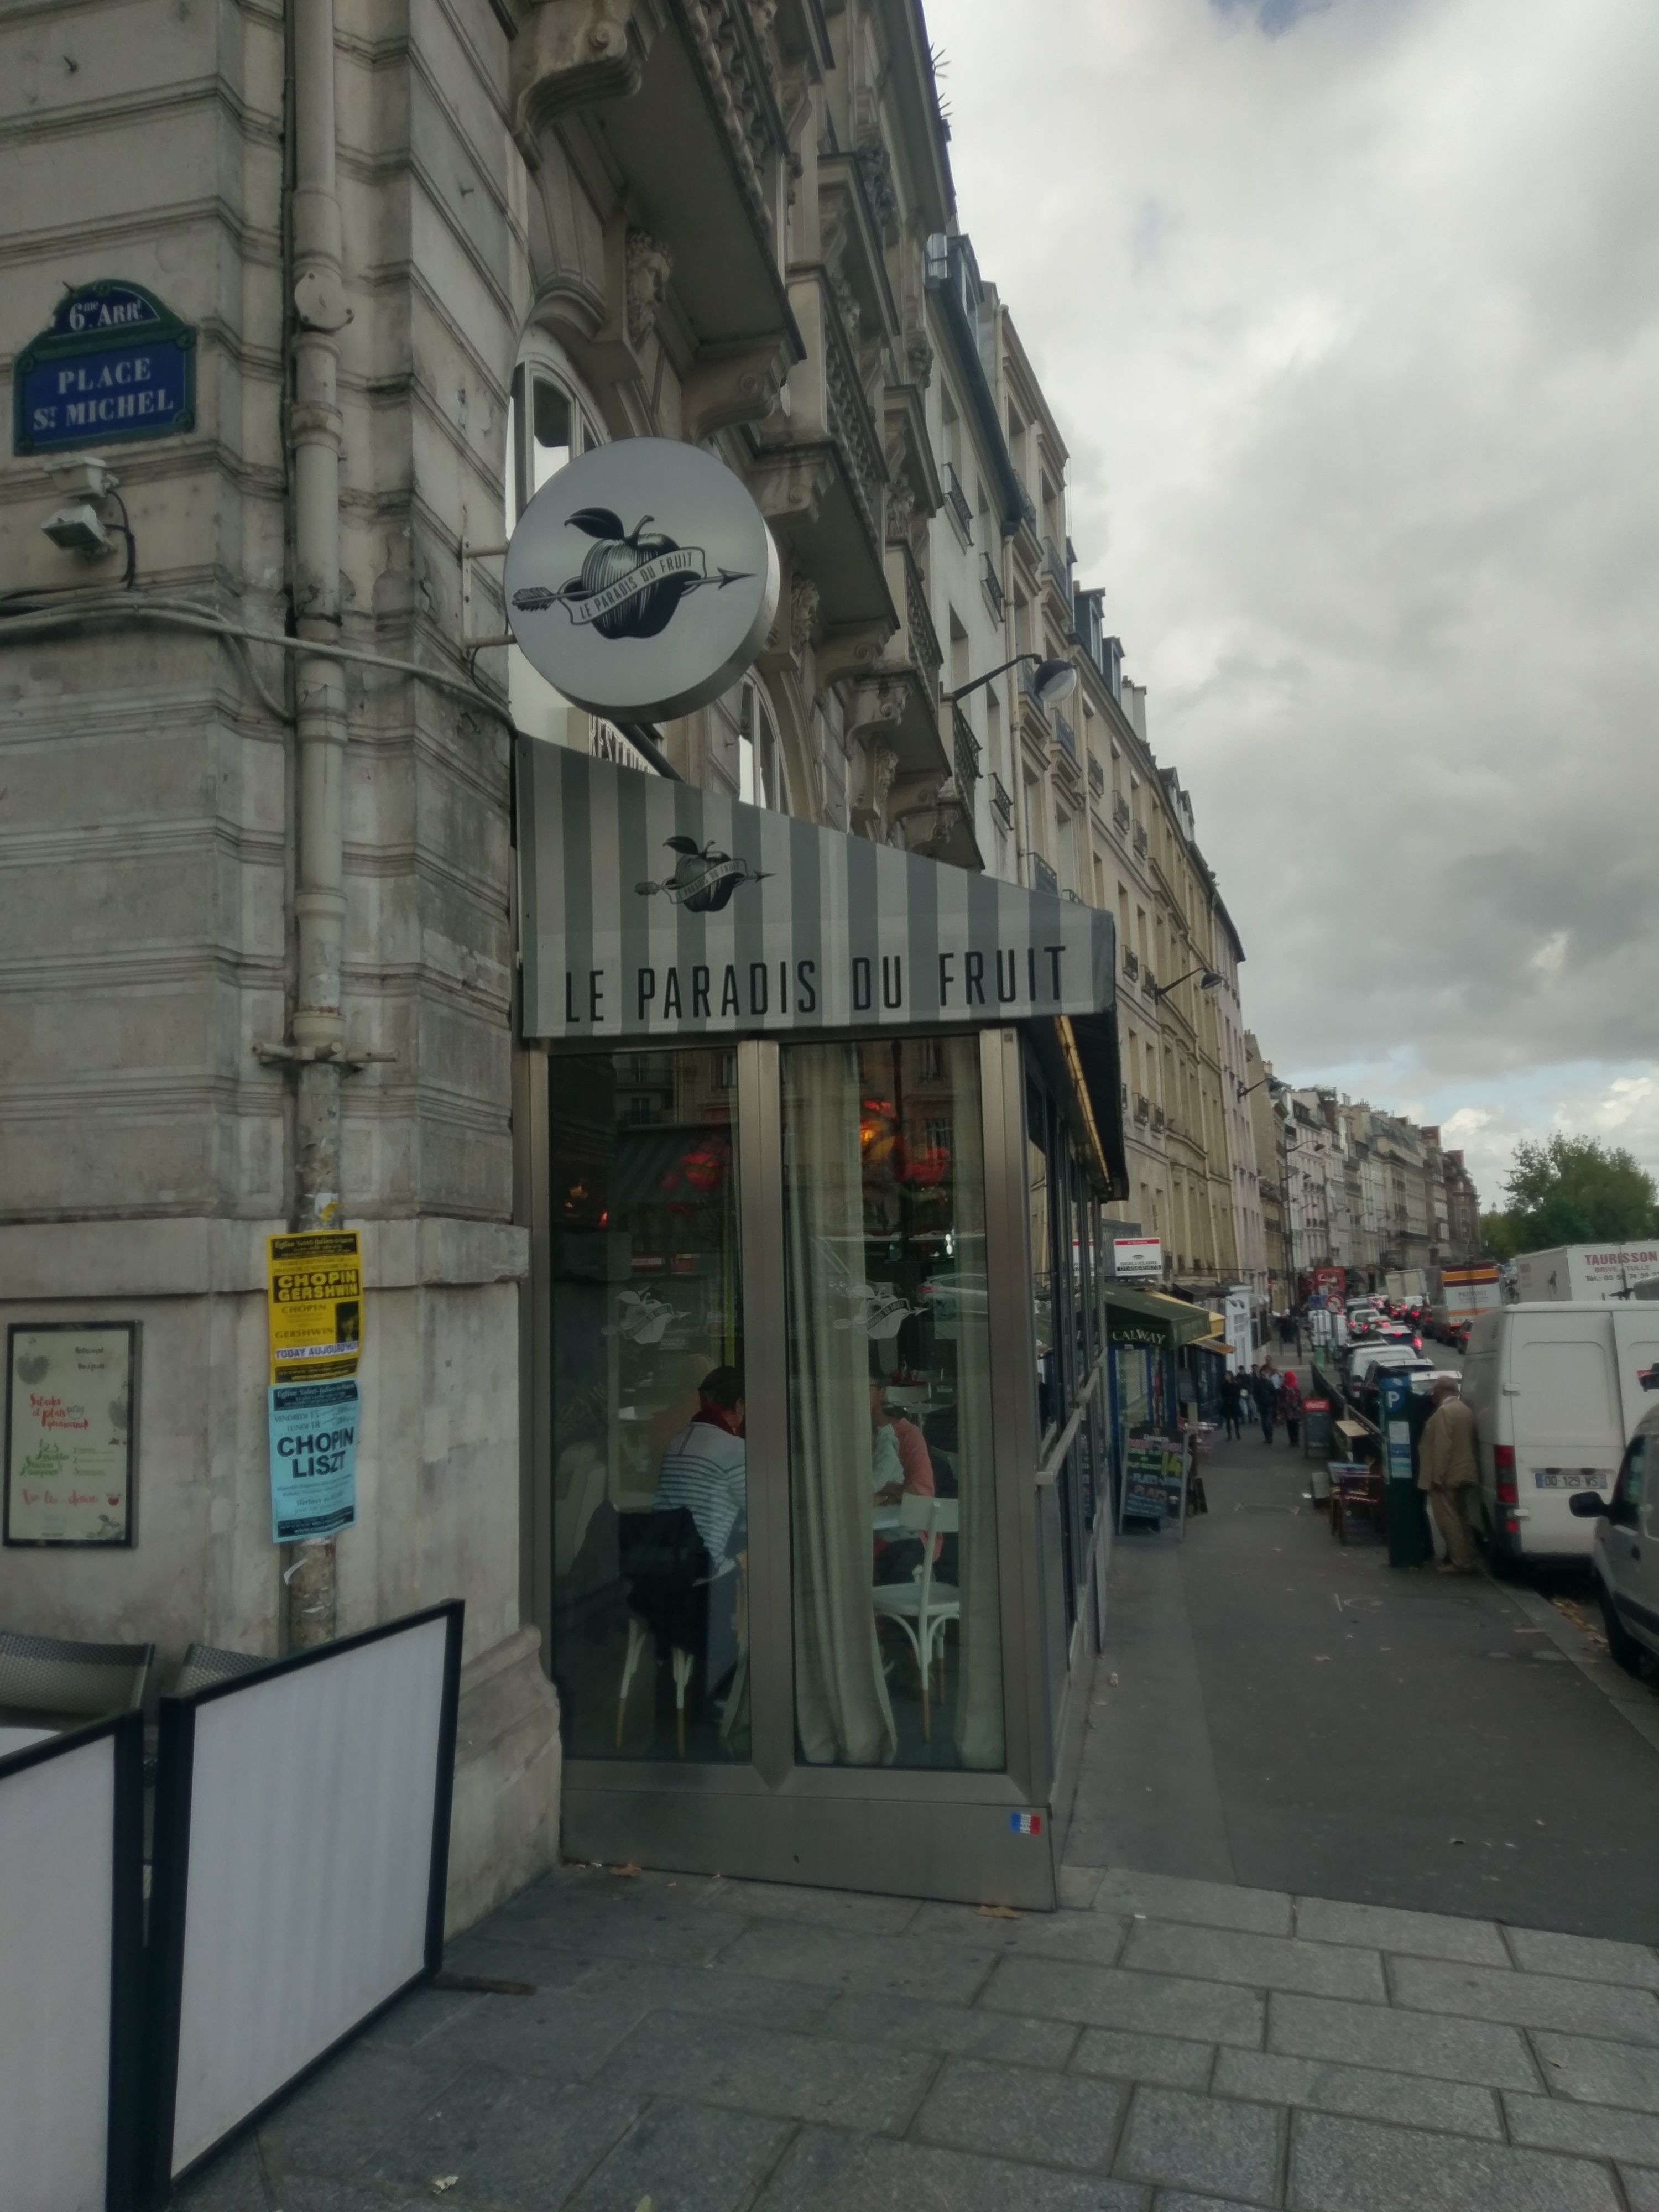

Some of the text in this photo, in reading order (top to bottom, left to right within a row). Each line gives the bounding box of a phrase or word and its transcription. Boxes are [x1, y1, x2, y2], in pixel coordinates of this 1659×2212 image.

[58, 357, 152, 394] PLACE
[65, 388, 174, 427] MICHEL
[579, 551, 693, 620] LE PARADIS DU FRUIT
[565, 945, 1066, 1023] LE PARADIS DU FRUIT
[1584, 1251, 1658, 1265] TAURISSON
[278, 1270, 358, 1289] CHOPIN
[278, 1282, 358, 1302] GERSHWIN
[281, 1303, 327, 1314] CHOPIN
[275, 1327, 334, 1339] GERSHWIN
[1112, 1328, 1166, 1345] GALWAY
[276, 1347, 305, 1358] TODAY
[1387, 1391, 1400, 1408] P
[276, 1426, 354, 1457] CHOPIN
[291, 1449, 346, 1479] LISZT
